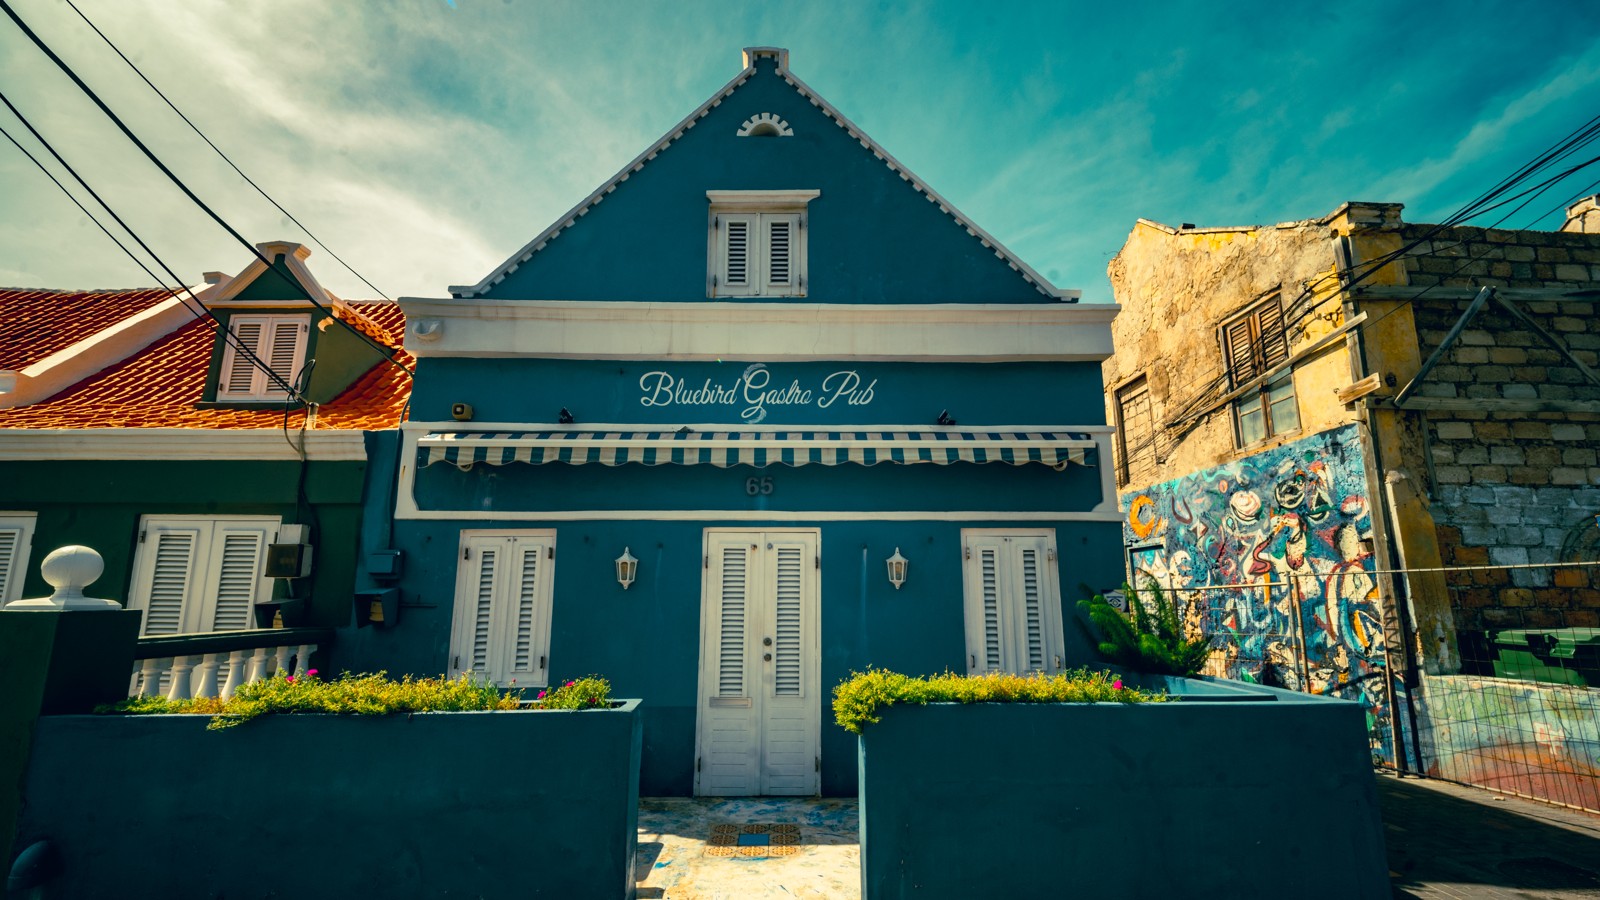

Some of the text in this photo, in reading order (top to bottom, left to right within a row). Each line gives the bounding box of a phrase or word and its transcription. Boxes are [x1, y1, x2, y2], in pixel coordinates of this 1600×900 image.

[639, 371, 741, 407] Bluebird
[817, 369, 878, 408] Pub
[745, 476, 774, 495] 65
